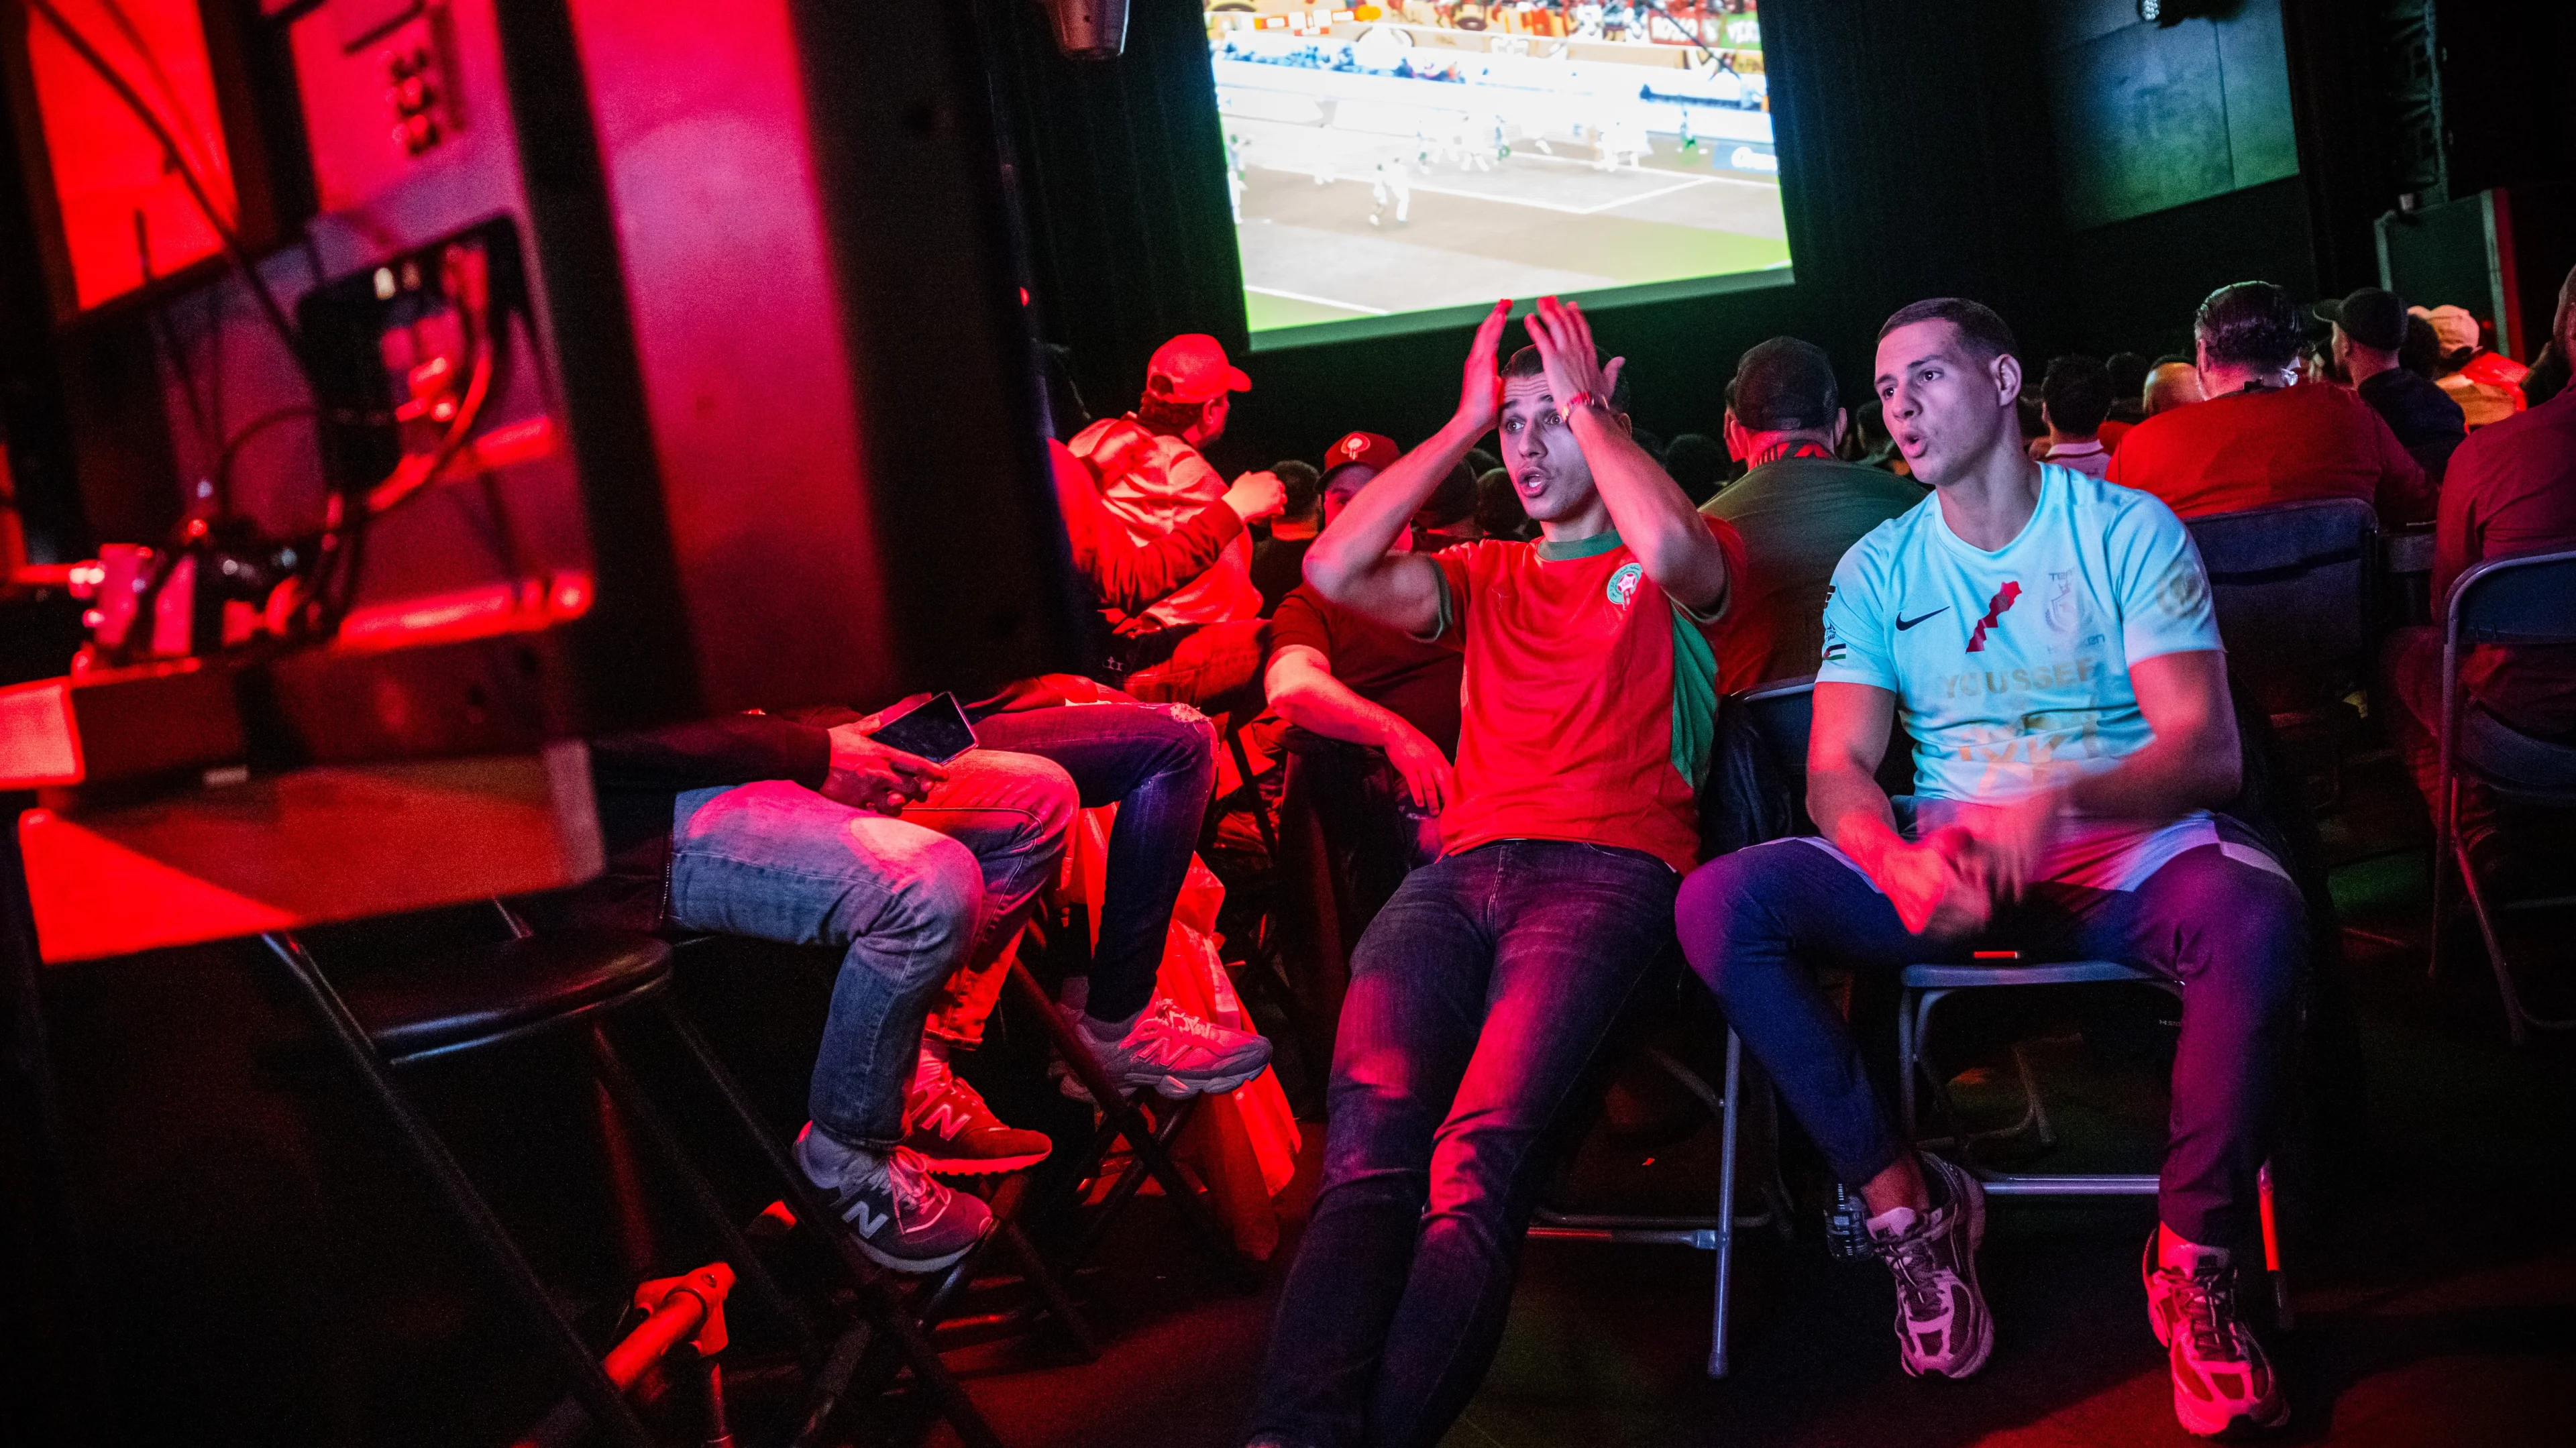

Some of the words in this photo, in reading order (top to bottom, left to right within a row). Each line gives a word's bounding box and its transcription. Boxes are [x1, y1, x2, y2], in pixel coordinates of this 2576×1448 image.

[1943, 657, 2094, 698] YOUSSEF
[1137, 1037, 1192, 1067] N
[921, 1102, 972, 1141] N
[841, 1201, 890, 1239] N
